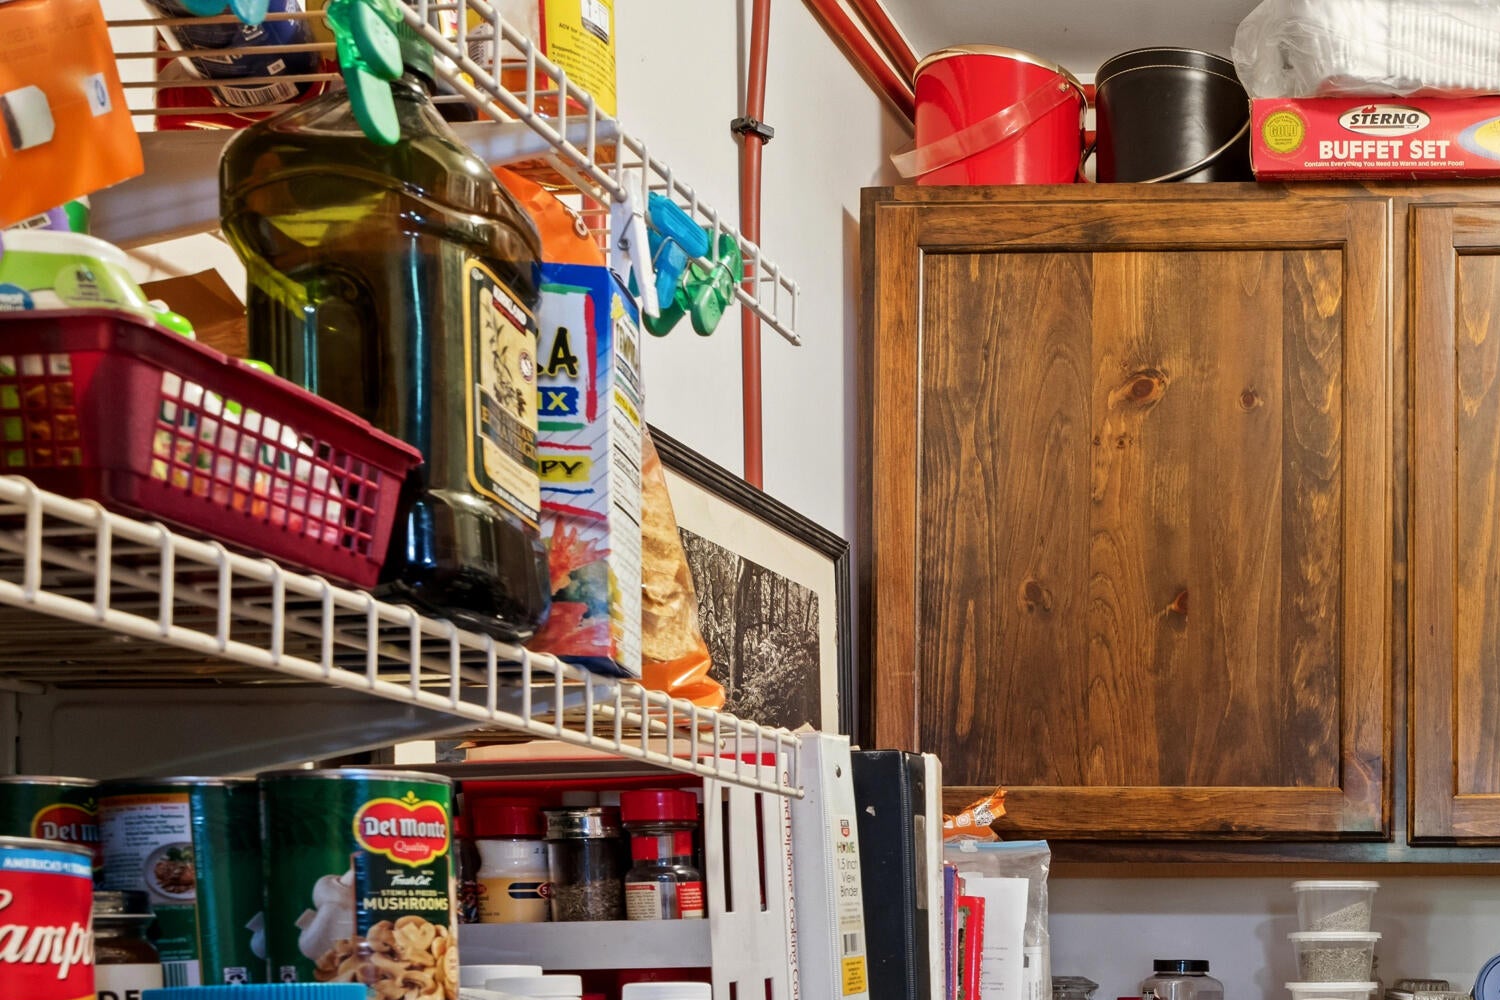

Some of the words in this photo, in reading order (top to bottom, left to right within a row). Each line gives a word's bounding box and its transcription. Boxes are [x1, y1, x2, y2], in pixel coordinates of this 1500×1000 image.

[1350, 113, 1420, 125] STERNO
[1319, 140, 1403, 160] BUFFET
[1409, 139, 1450, 160] SET
[1331, 160, 1362, 169] Everything
[41, 821, 76, 841] Del
[364, 816, 398, 837] Del
[399, 817, 446, 839] Monte
[393, 840, 430, 854] Quality
[362, 897, 449, 911] MUSHROOMS
